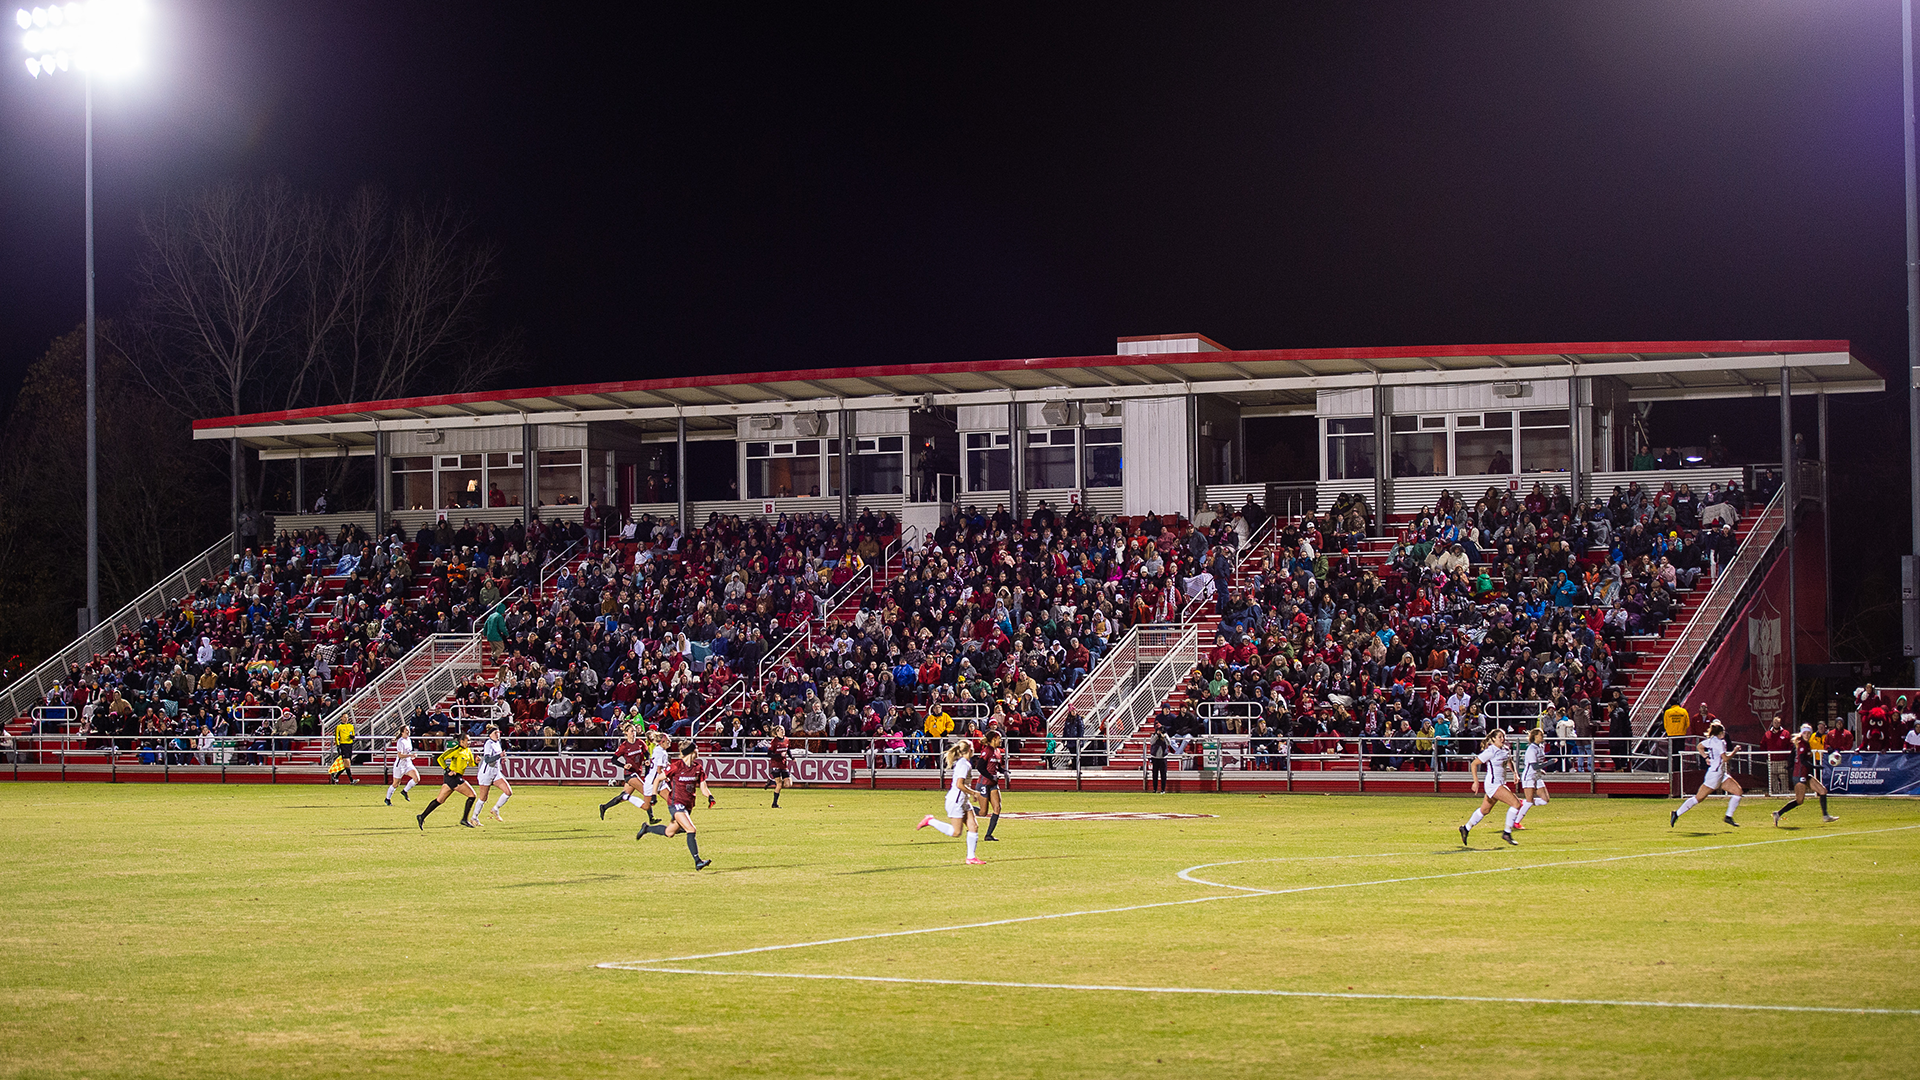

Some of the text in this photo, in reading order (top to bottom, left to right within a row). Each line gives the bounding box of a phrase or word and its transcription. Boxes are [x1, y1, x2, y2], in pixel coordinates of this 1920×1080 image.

[1070, 494, 1078, 503] C
[766, 504, 772, 513] B
[695, 759, 849, 781] AZORACKS
[1850, 771, 1877, 779] SOCCER
[980, 786, 987, 795] 3
